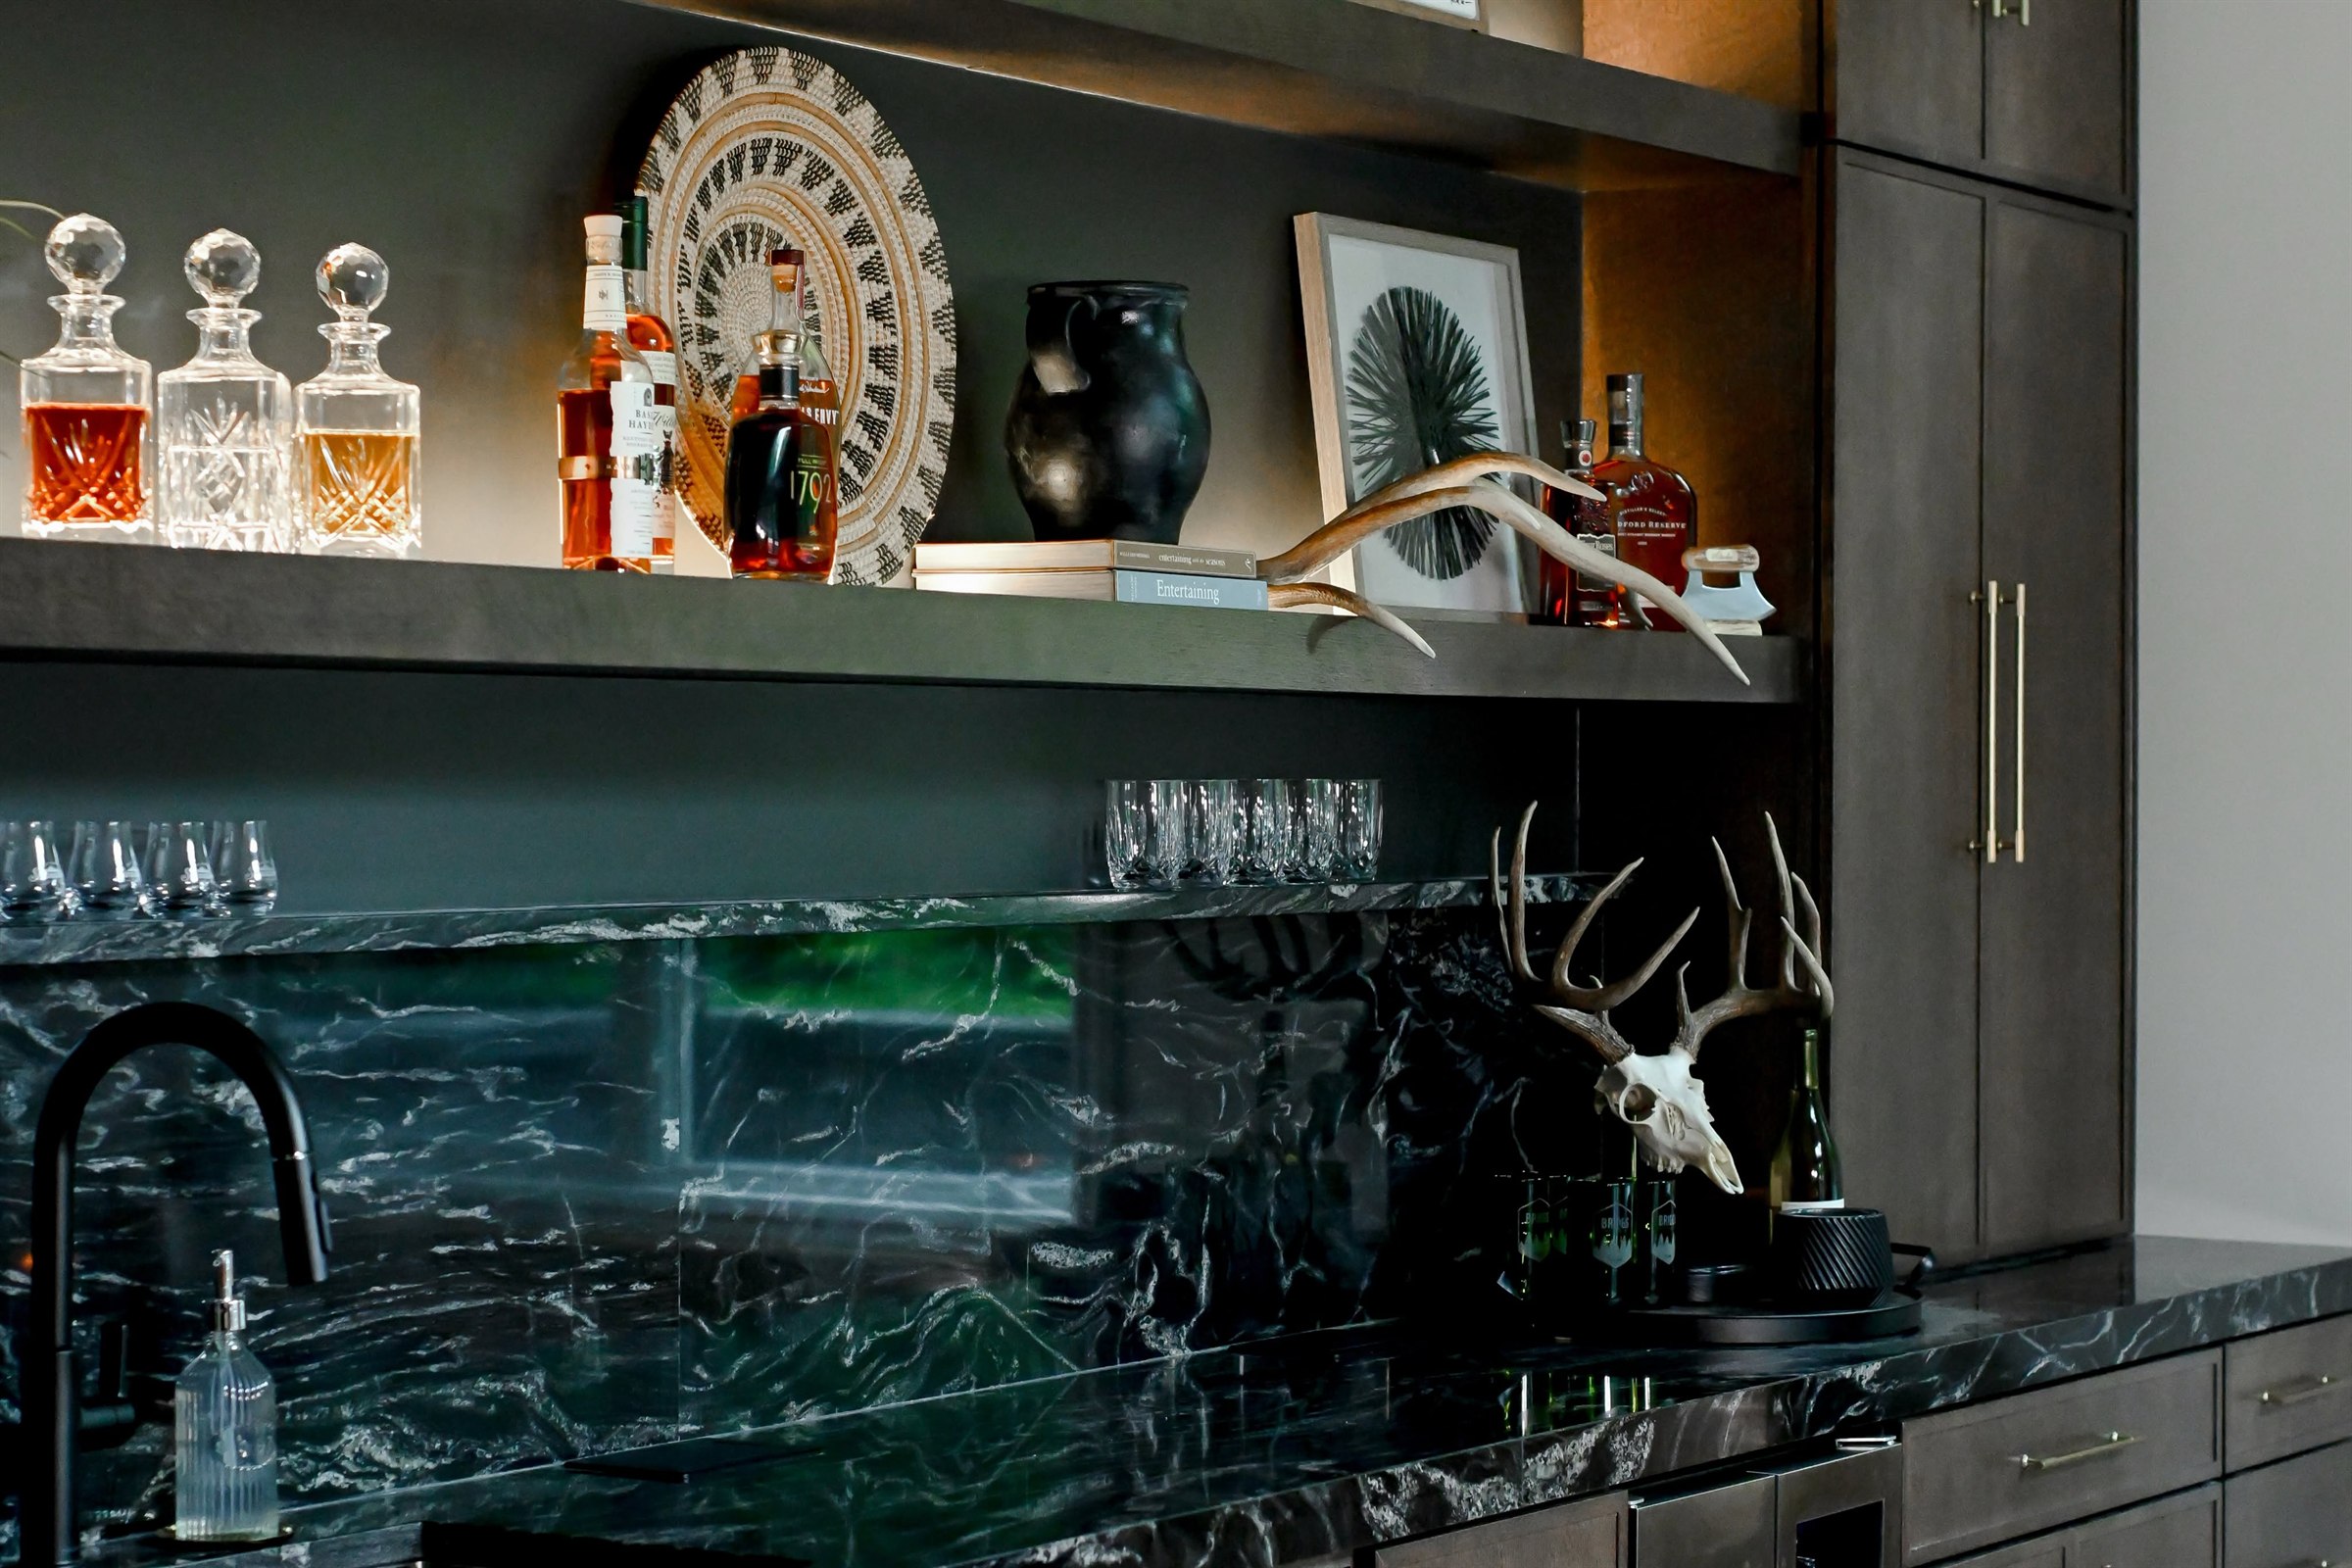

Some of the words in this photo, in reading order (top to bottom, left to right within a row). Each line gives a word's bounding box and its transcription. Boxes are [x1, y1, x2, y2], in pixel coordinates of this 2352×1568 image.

[814, 408, 840, 425] ENVY
[790, 470, 832, 514] 1792
[1617, 520, 1646, 529] DFORD
[1648, 520, 1687, 529] RESERVE
[1158, 552, 1193, 565] entertaining
[1156, 579, 1220, 606] Entertaining
